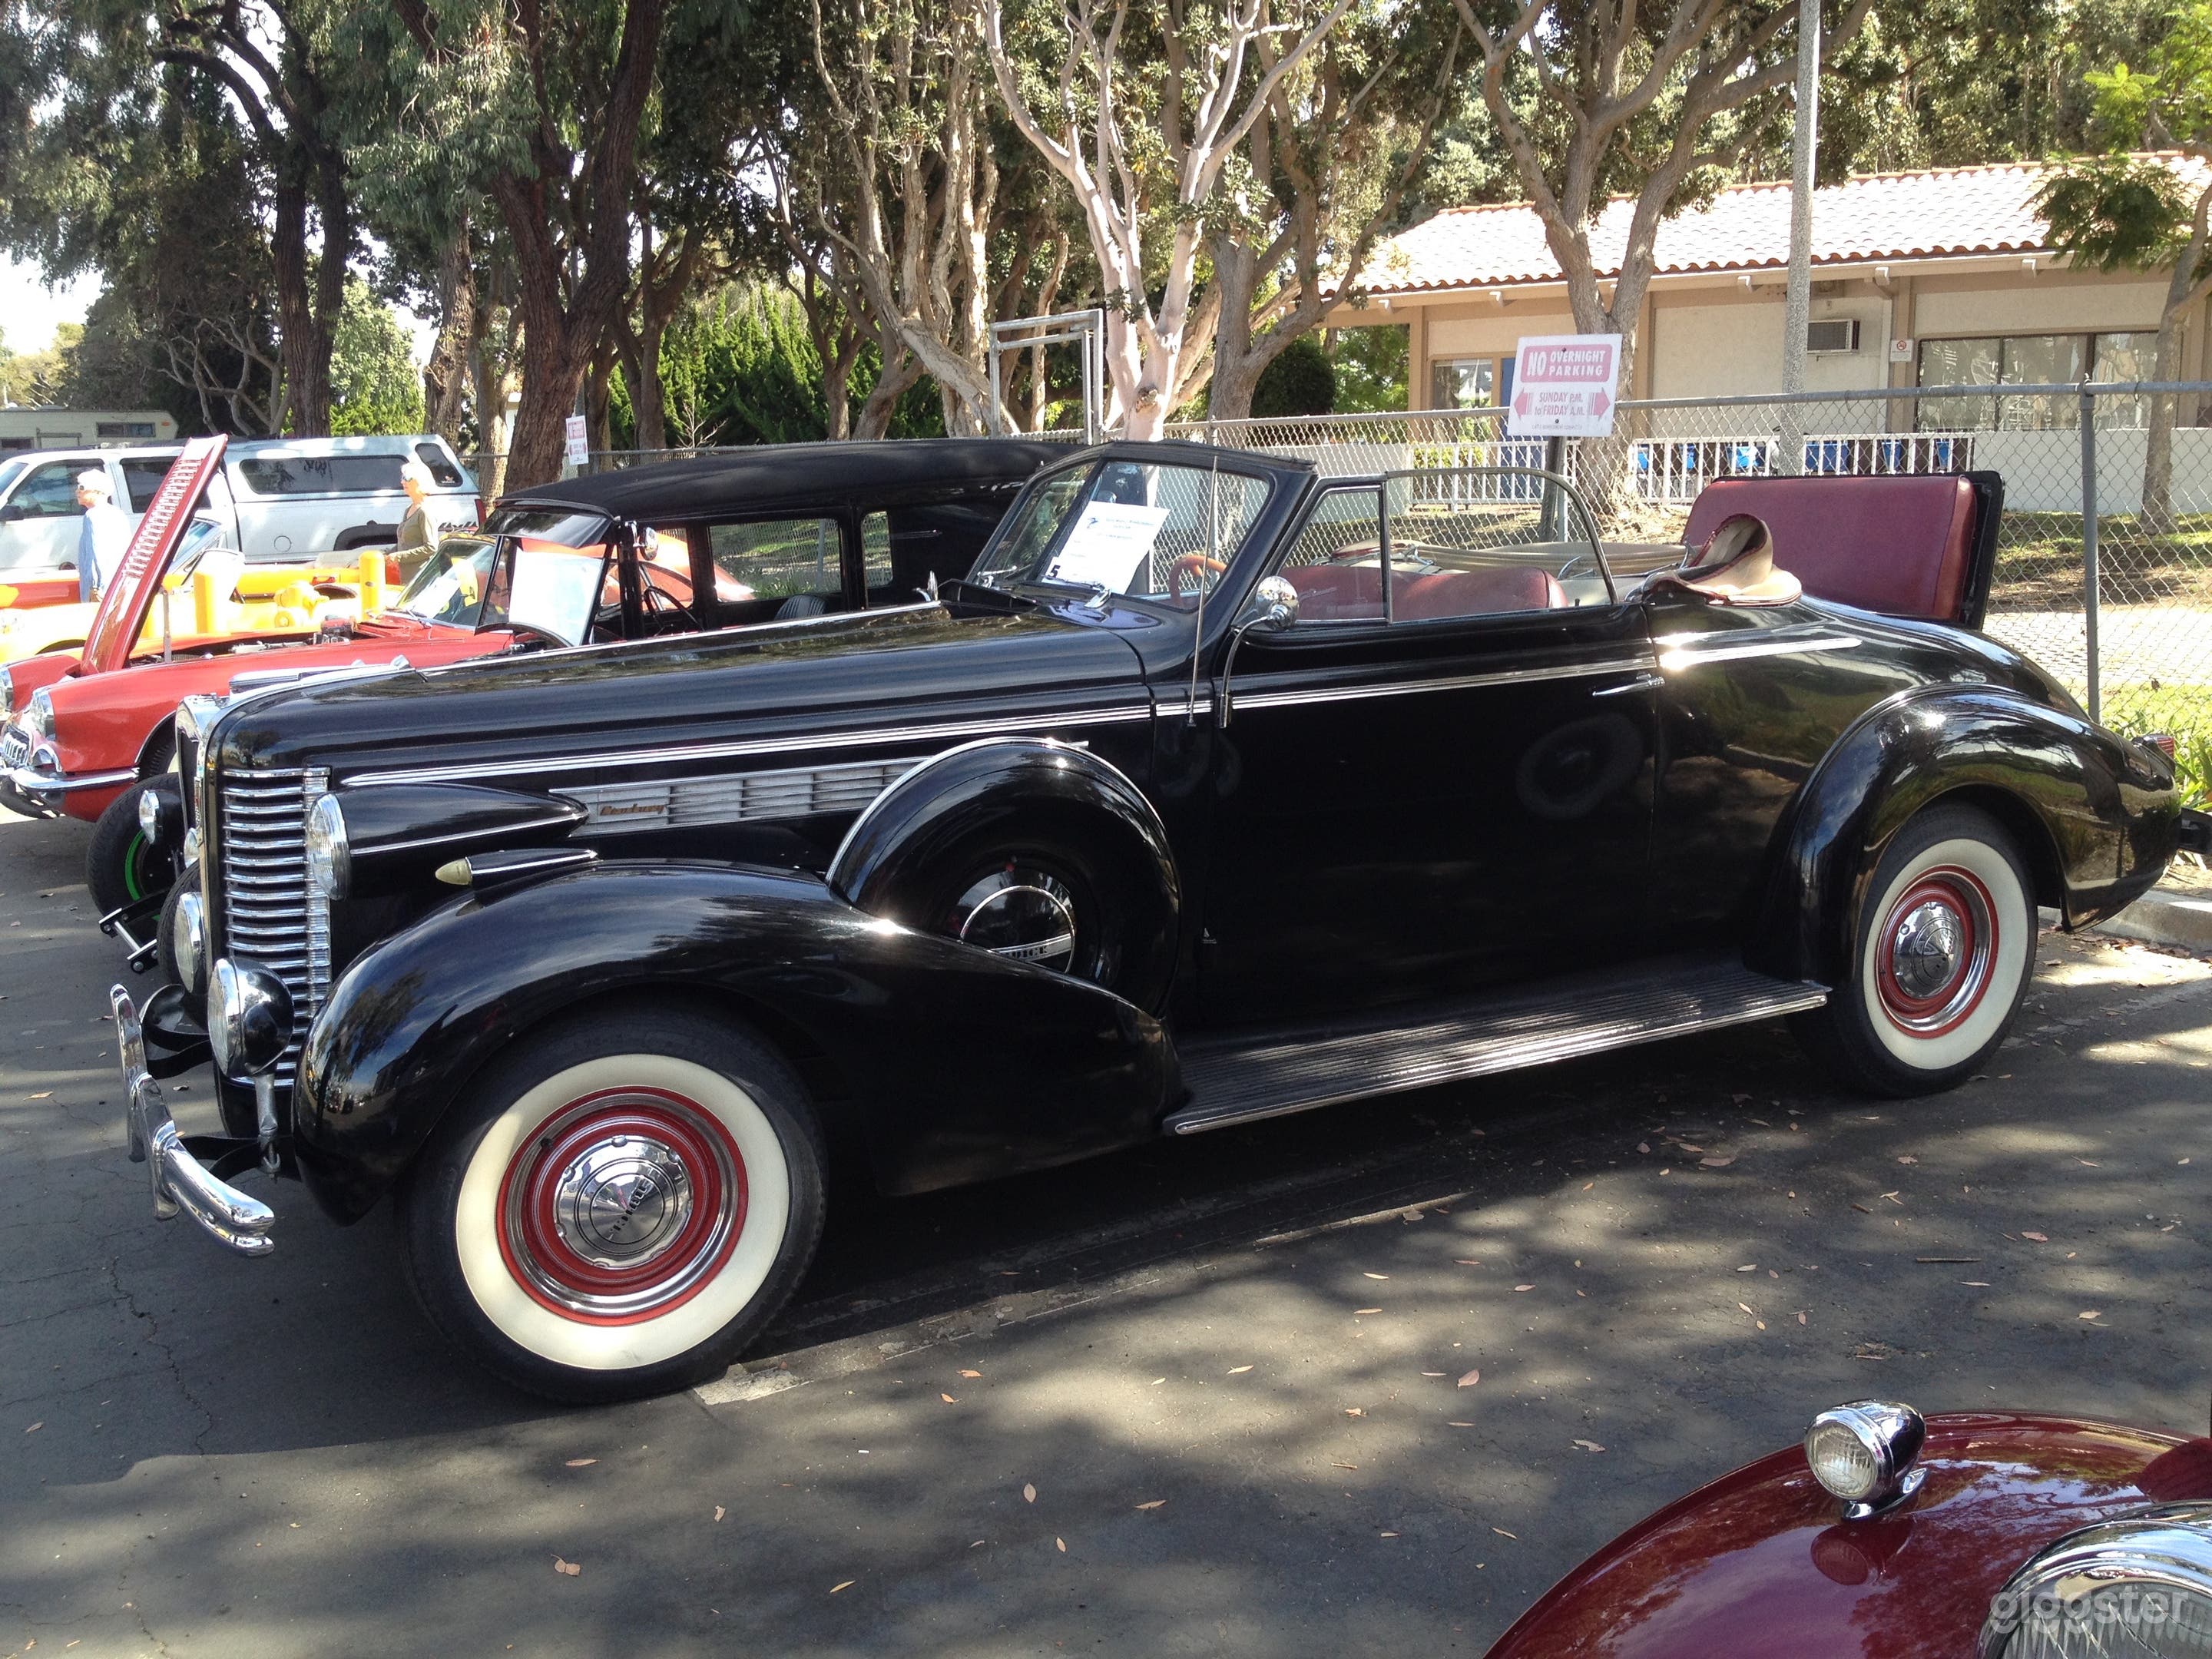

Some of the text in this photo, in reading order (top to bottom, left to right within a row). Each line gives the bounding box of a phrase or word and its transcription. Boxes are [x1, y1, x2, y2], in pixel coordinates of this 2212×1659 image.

[1527, 350, 1605, 376] NO OVERNIGHT
[1549, 365, 1603, 376] PARKING
[1539, 392, 1584, 403] SUNDAY P.M.
[1535, 405, 1585, 416] to FRIDAY A.M.
